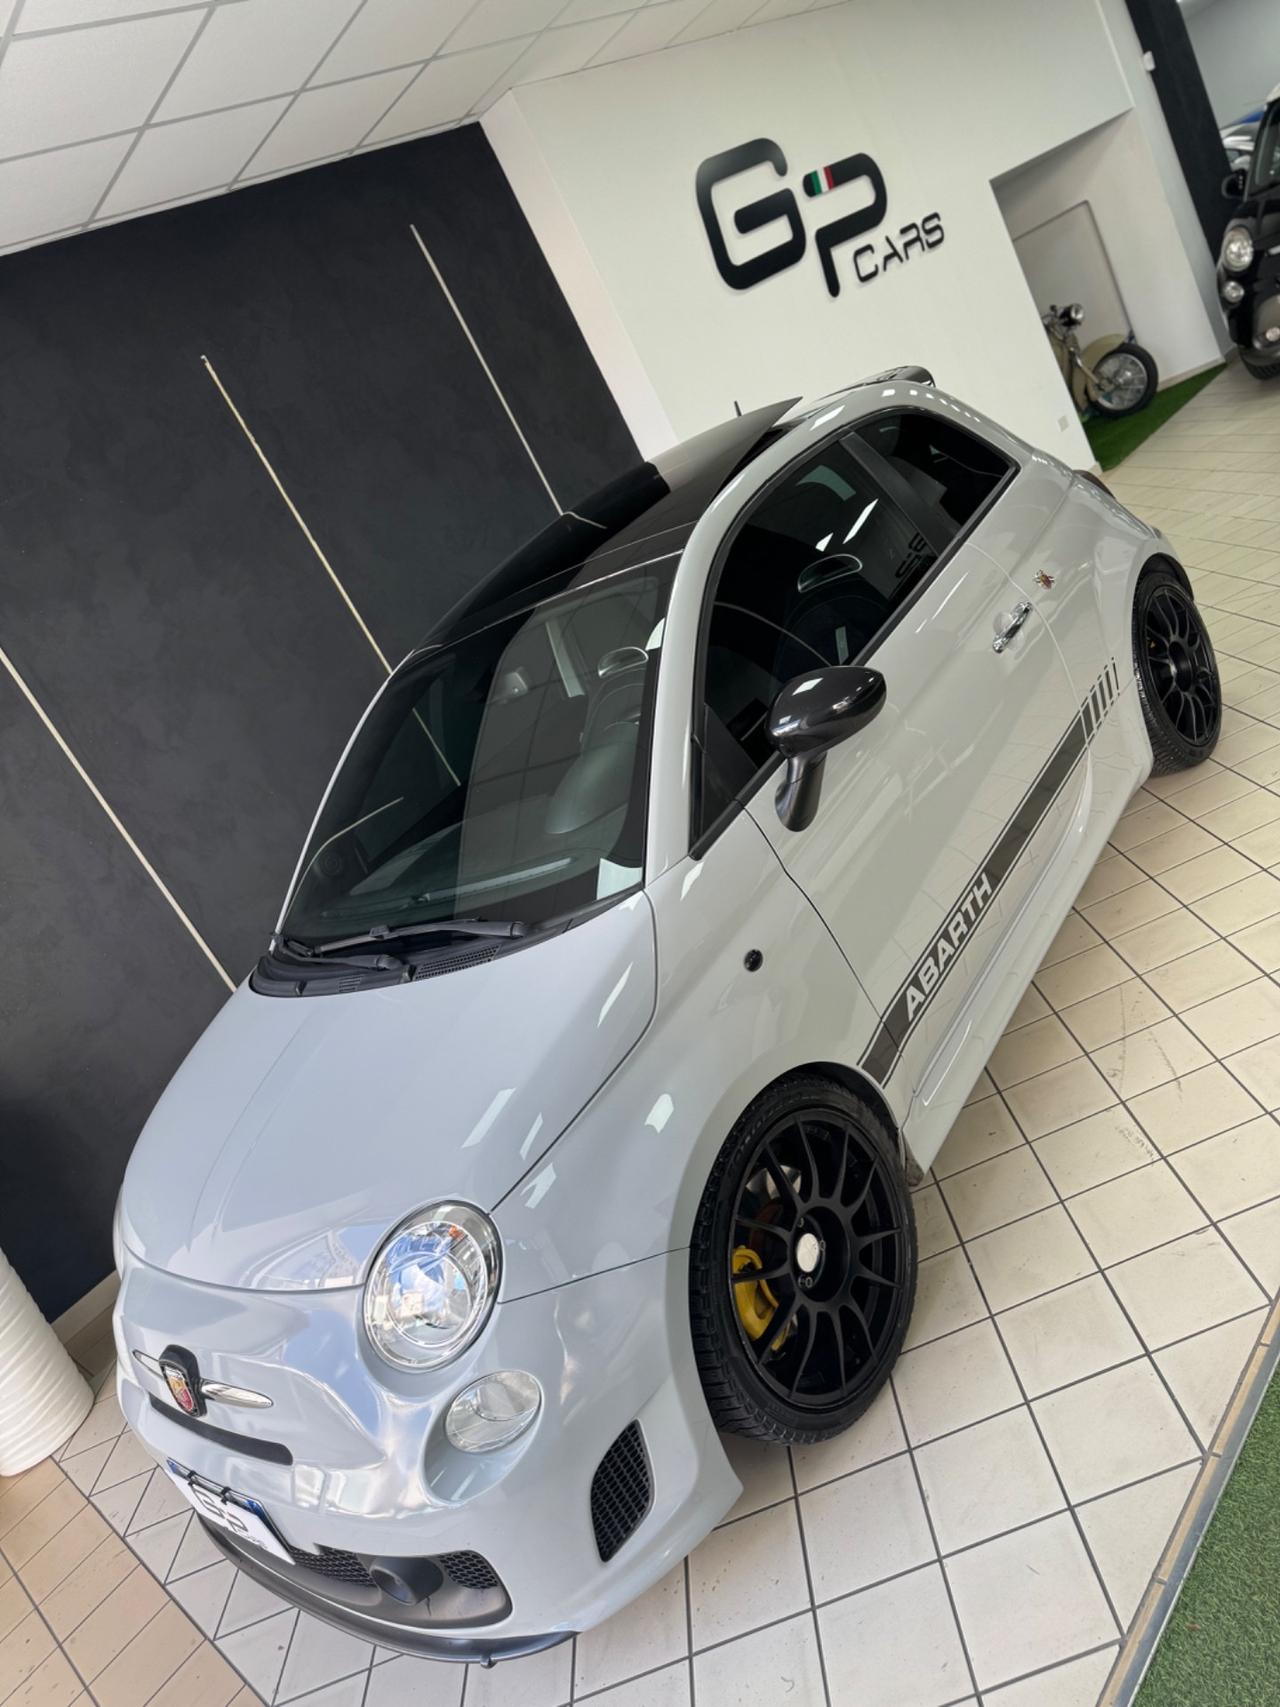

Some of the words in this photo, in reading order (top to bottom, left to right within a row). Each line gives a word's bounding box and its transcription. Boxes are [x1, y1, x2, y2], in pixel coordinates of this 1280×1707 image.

[695, 138, 888, 298] GP
[853, 212, 945, 283] CARS
[905, 872, 993, 1022] ABARTH
